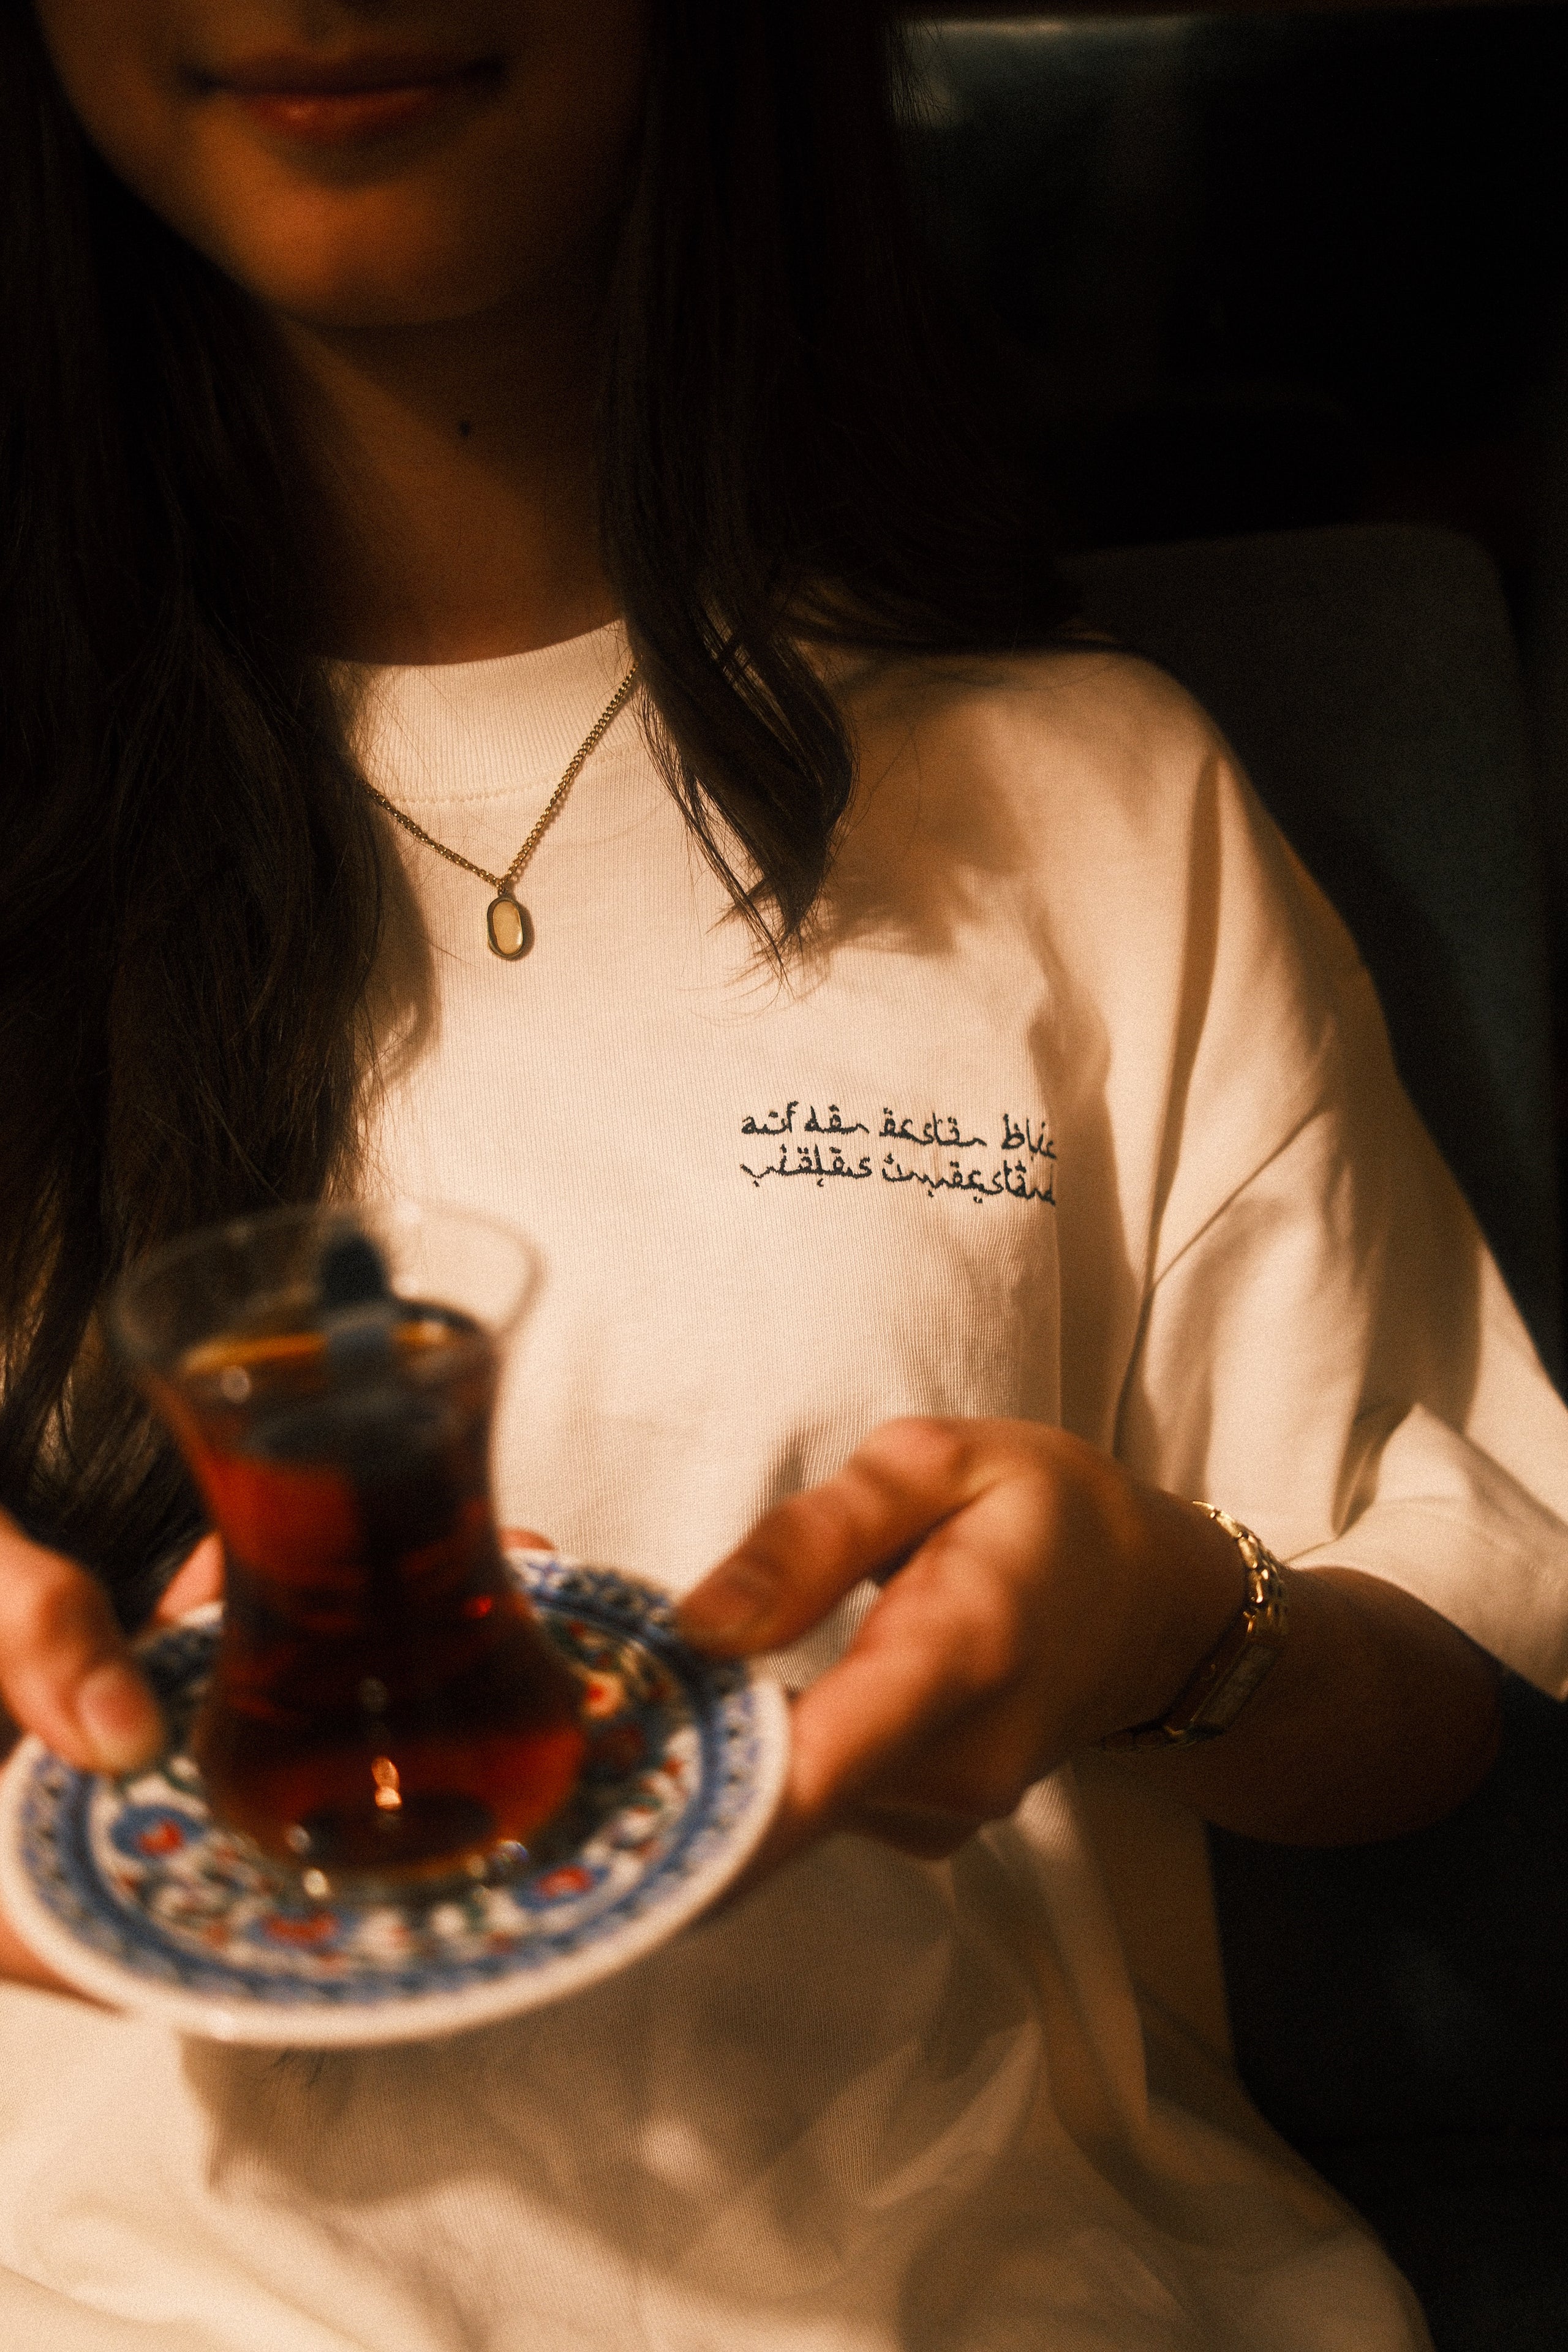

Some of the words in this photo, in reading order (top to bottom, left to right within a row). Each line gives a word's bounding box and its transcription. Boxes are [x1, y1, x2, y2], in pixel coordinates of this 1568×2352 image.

[741, 1101, 799, 1136] auf
[804, 1106, 870, 1135] den
[880, 1107, 987, 1147] ersten
[1001, 1113, 1057, 1161] blic
